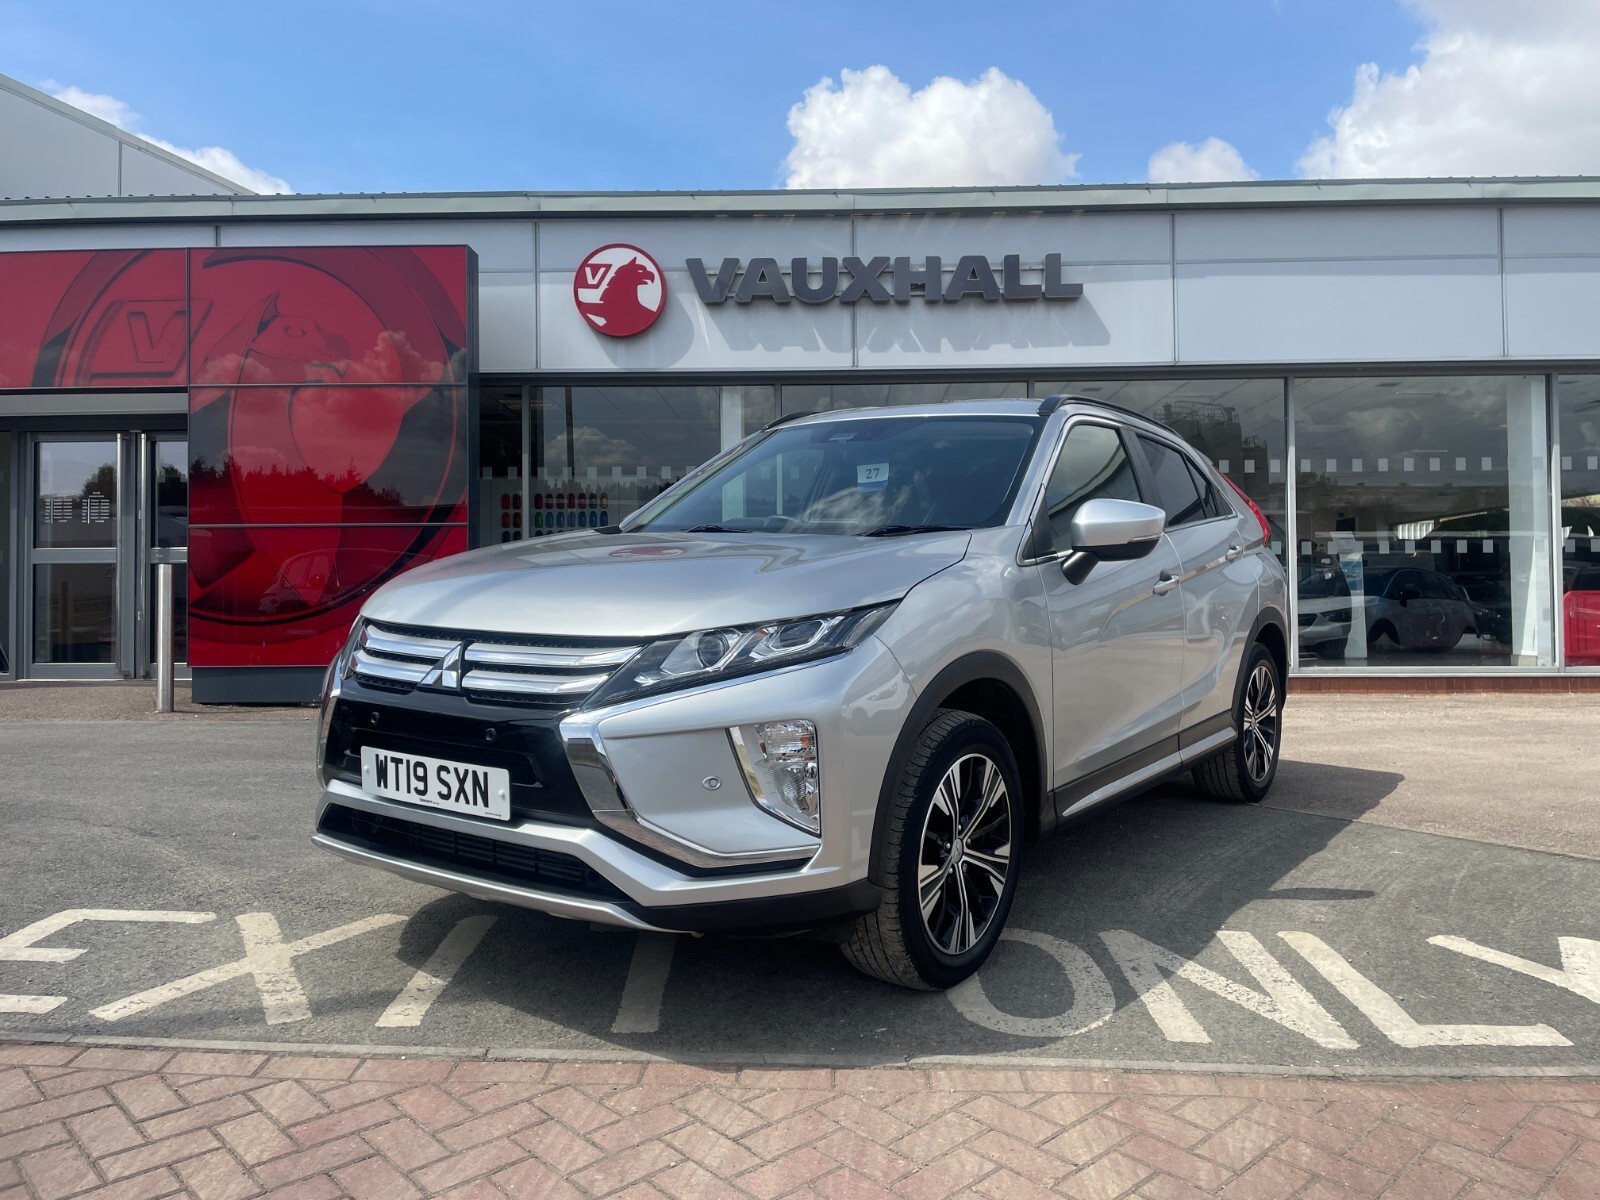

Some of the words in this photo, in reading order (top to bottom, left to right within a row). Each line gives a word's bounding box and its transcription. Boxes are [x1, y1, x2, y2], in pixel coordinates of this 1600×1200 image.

[584, 266, 606, 285] V
[685, 253, 1083, 304] VAUXHALL
[865, 467, 880, 480] 27
[375, 753, 428, 797] WT19
[436, 764, 490, 808] SXN
